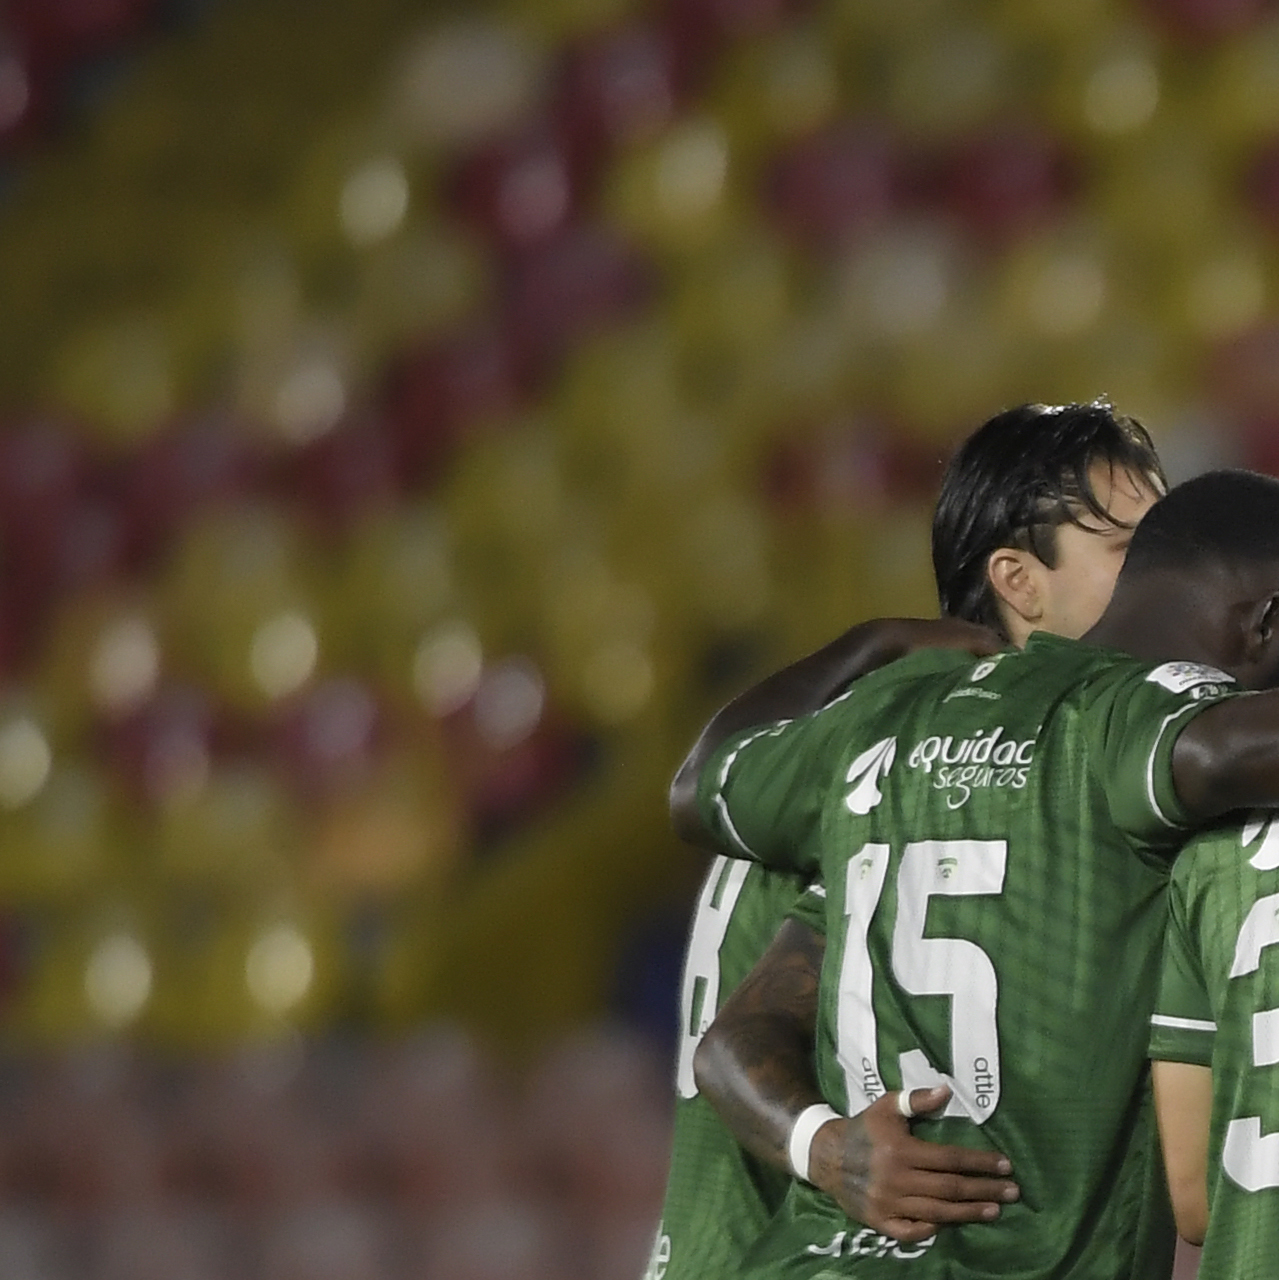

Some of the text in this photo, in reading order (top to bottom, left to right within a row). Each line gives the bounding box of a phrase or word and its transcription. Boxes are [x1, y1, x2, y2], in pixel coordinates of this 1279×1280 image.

[932, 764, 1032, 810] seguros
[836, 839, 1007, 1125] 15
[973, 1057, 995, 1109] attle
